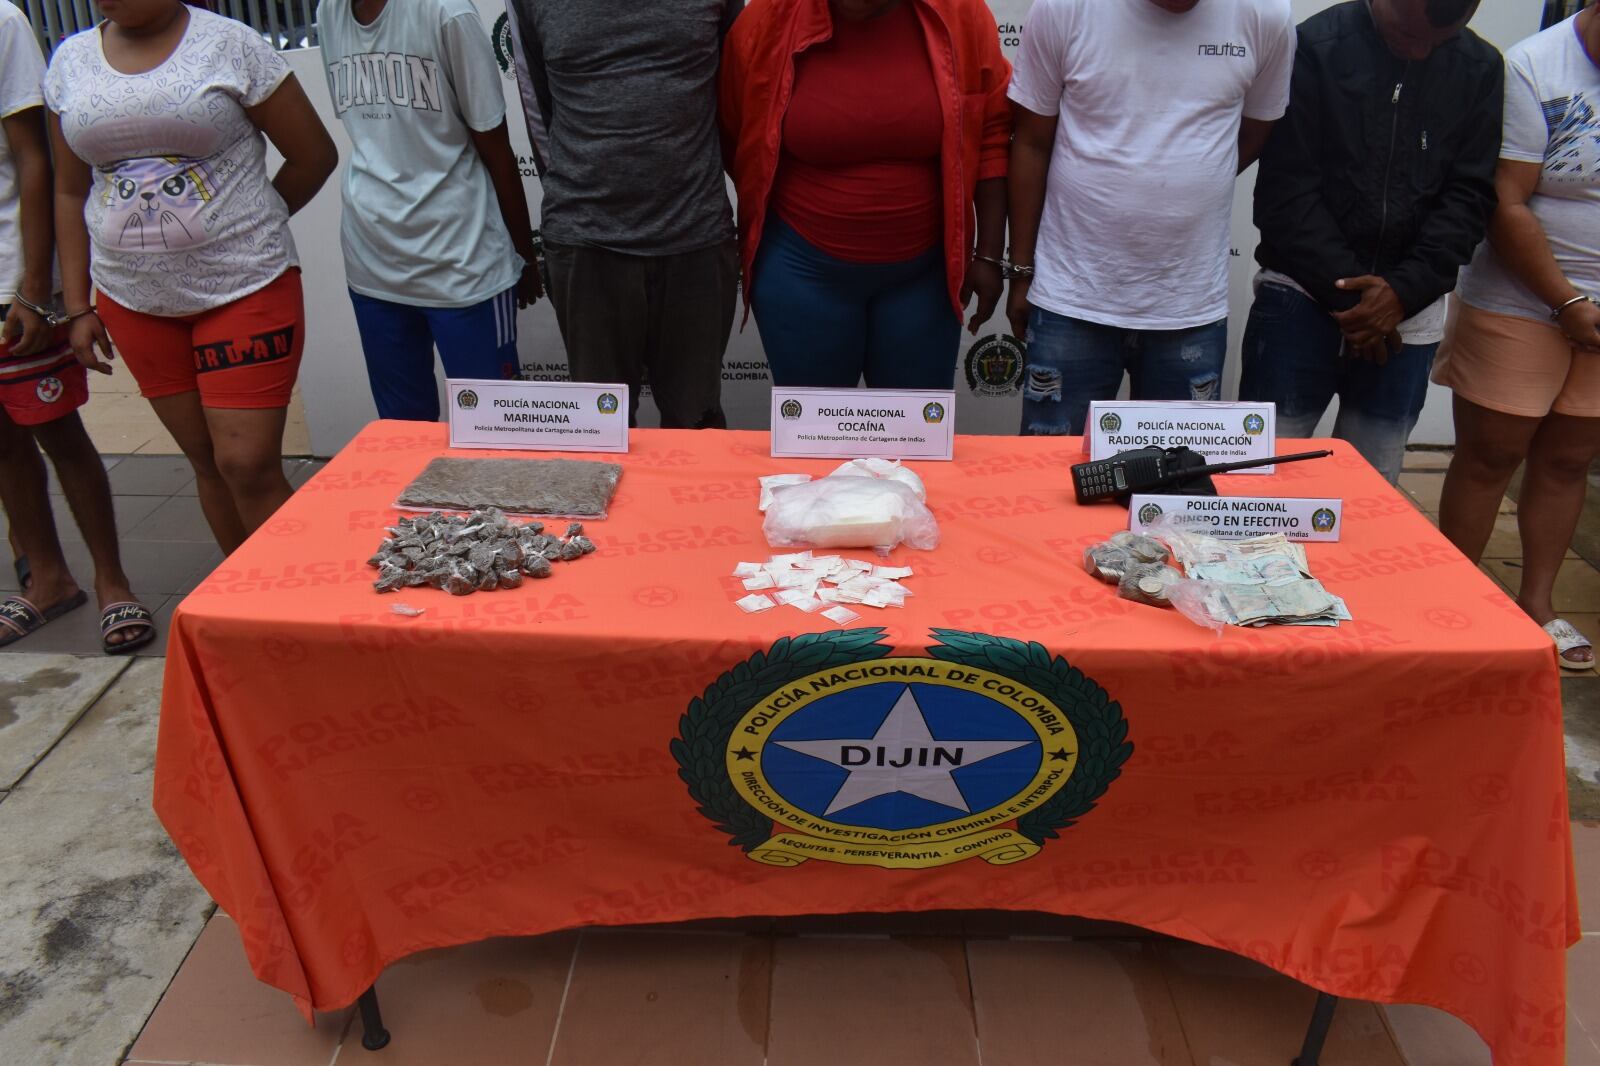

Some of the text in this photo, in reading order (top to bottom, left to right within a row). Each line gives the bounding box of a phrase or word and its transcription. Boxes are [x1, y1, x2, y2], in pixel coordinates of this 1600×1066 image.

[1198, 42, 1246, 58] nautica
[728, 361, 769, 369] NACION
[721, 372, 769, 381] OLOMBIA
[493, 398, 580, 410] POLICÍA NACIONAL
[504, 413, 570, 424] MARIHUANA
[818, 407, 906, 418] POLICÍA NACIONAL
[545, 427, 574, 435] Cartagena
[837, 420, 885, 432] COCAÍNA
[1137, 420, 1226, 431] POLICÍA NACIONAL
[868, 436, 898, 444] Cartagena
[1108, 433, 1252, 446] RADIOS DE COMUNICACIÓN
[1187, 499, 1287, 513] POLICÍA NACIONAL
[1224, 516, 1239, 526] EN
[1243, 517, 1299, 528] EFECTIVO
[942, 585, 1104, 626] POLIC
[744, 665, 1065, 736] POLICÍA NACIONAL DE COLOMBIA
[840, 745, 964, 768] DIJIN
[786, 813, 808, 826] DE
[808, 821, 932, 842] INVESTIGACIÓN
[935, 812, 1010, 836] CRIMINAL
[1007, 806, 1019, 815] E
[1017, 767, 1065, 810] INTERPOL
[777, 837, 836, 854] AEQUITAS
[843, 848, 942, 860] PERSEVERANTIA
[953, 832, 1013, 854] CONVIVIO
